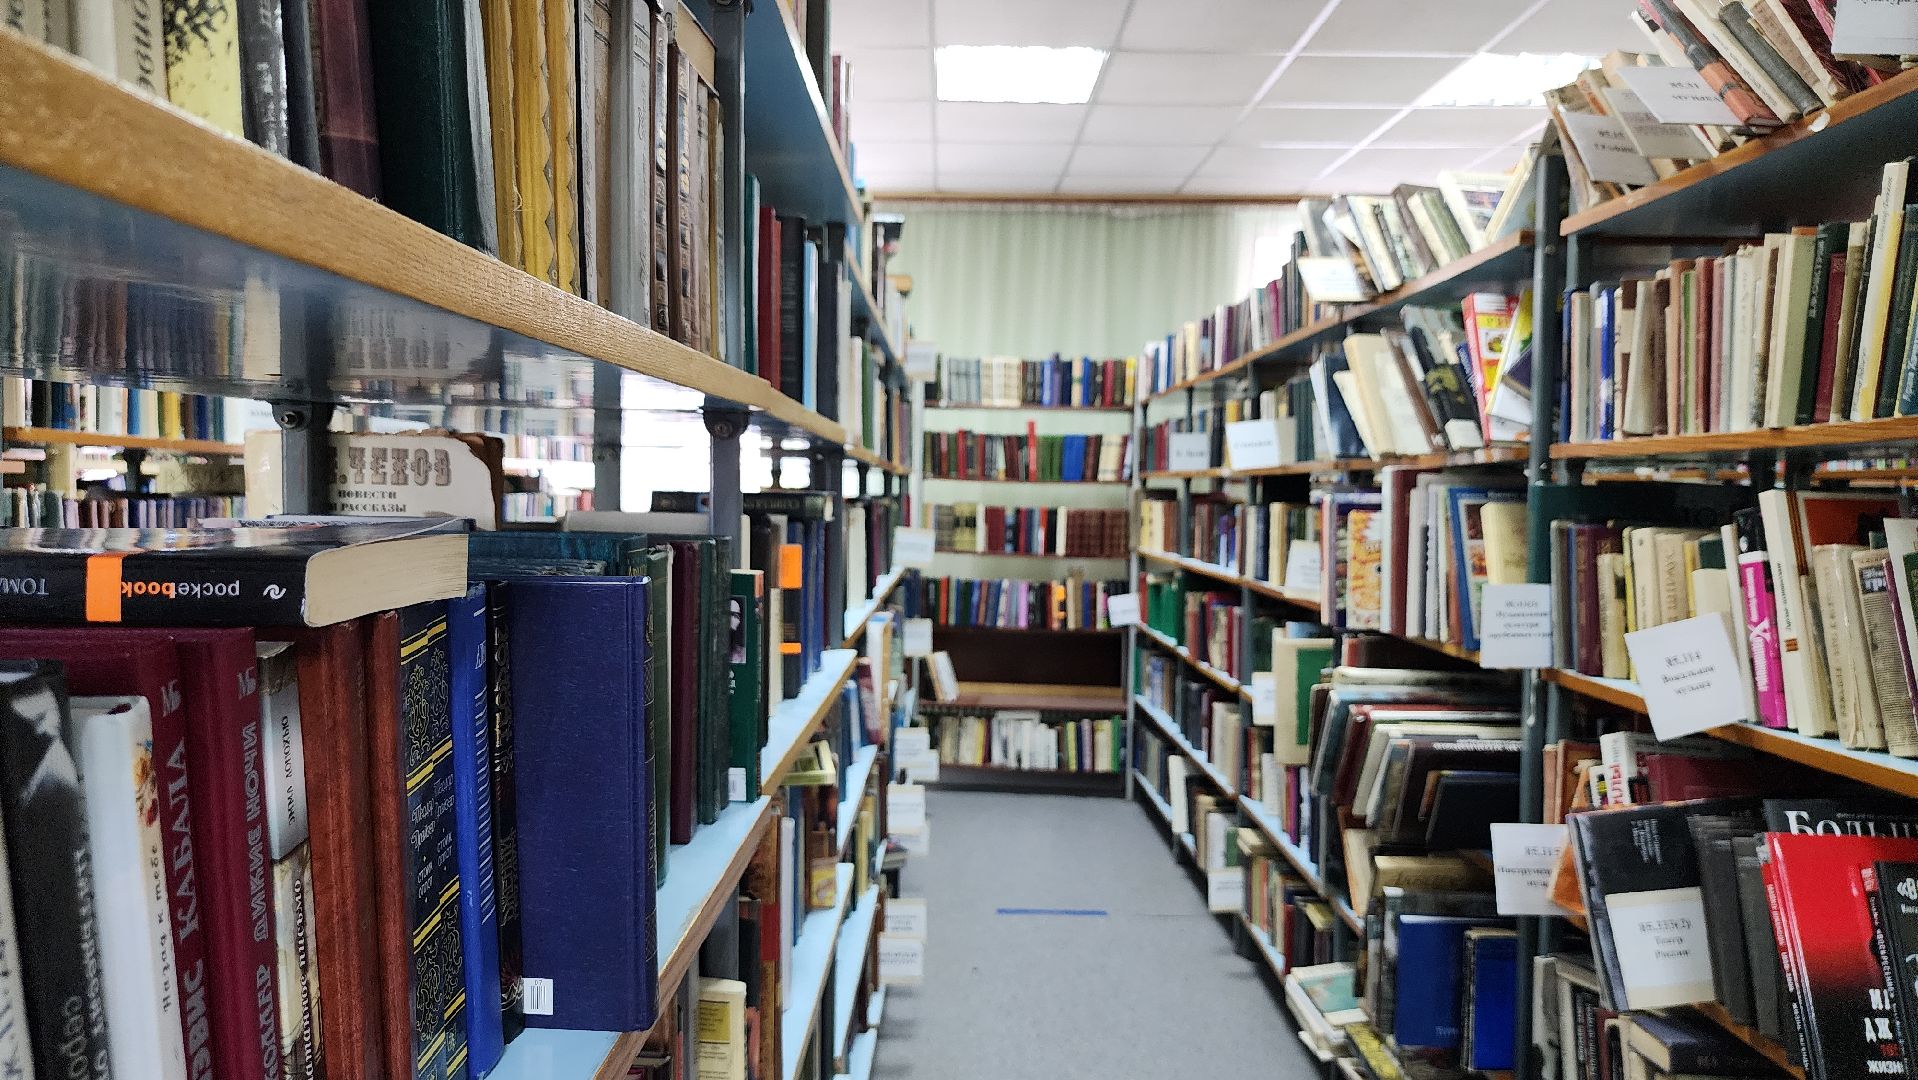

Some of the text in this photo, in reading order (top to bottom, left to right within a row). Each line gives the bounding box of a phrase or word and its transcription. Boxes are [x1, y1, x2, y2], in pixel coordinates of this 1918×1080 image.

[242, 721, 261, 822] НОЧИ
[150, 845, 162, 900] тебе
[166, 737, 199, 944] КАБАЛА
[248, 822, 269, 942] ДИКИЕ
[293, 879, 307, 973] письмо
